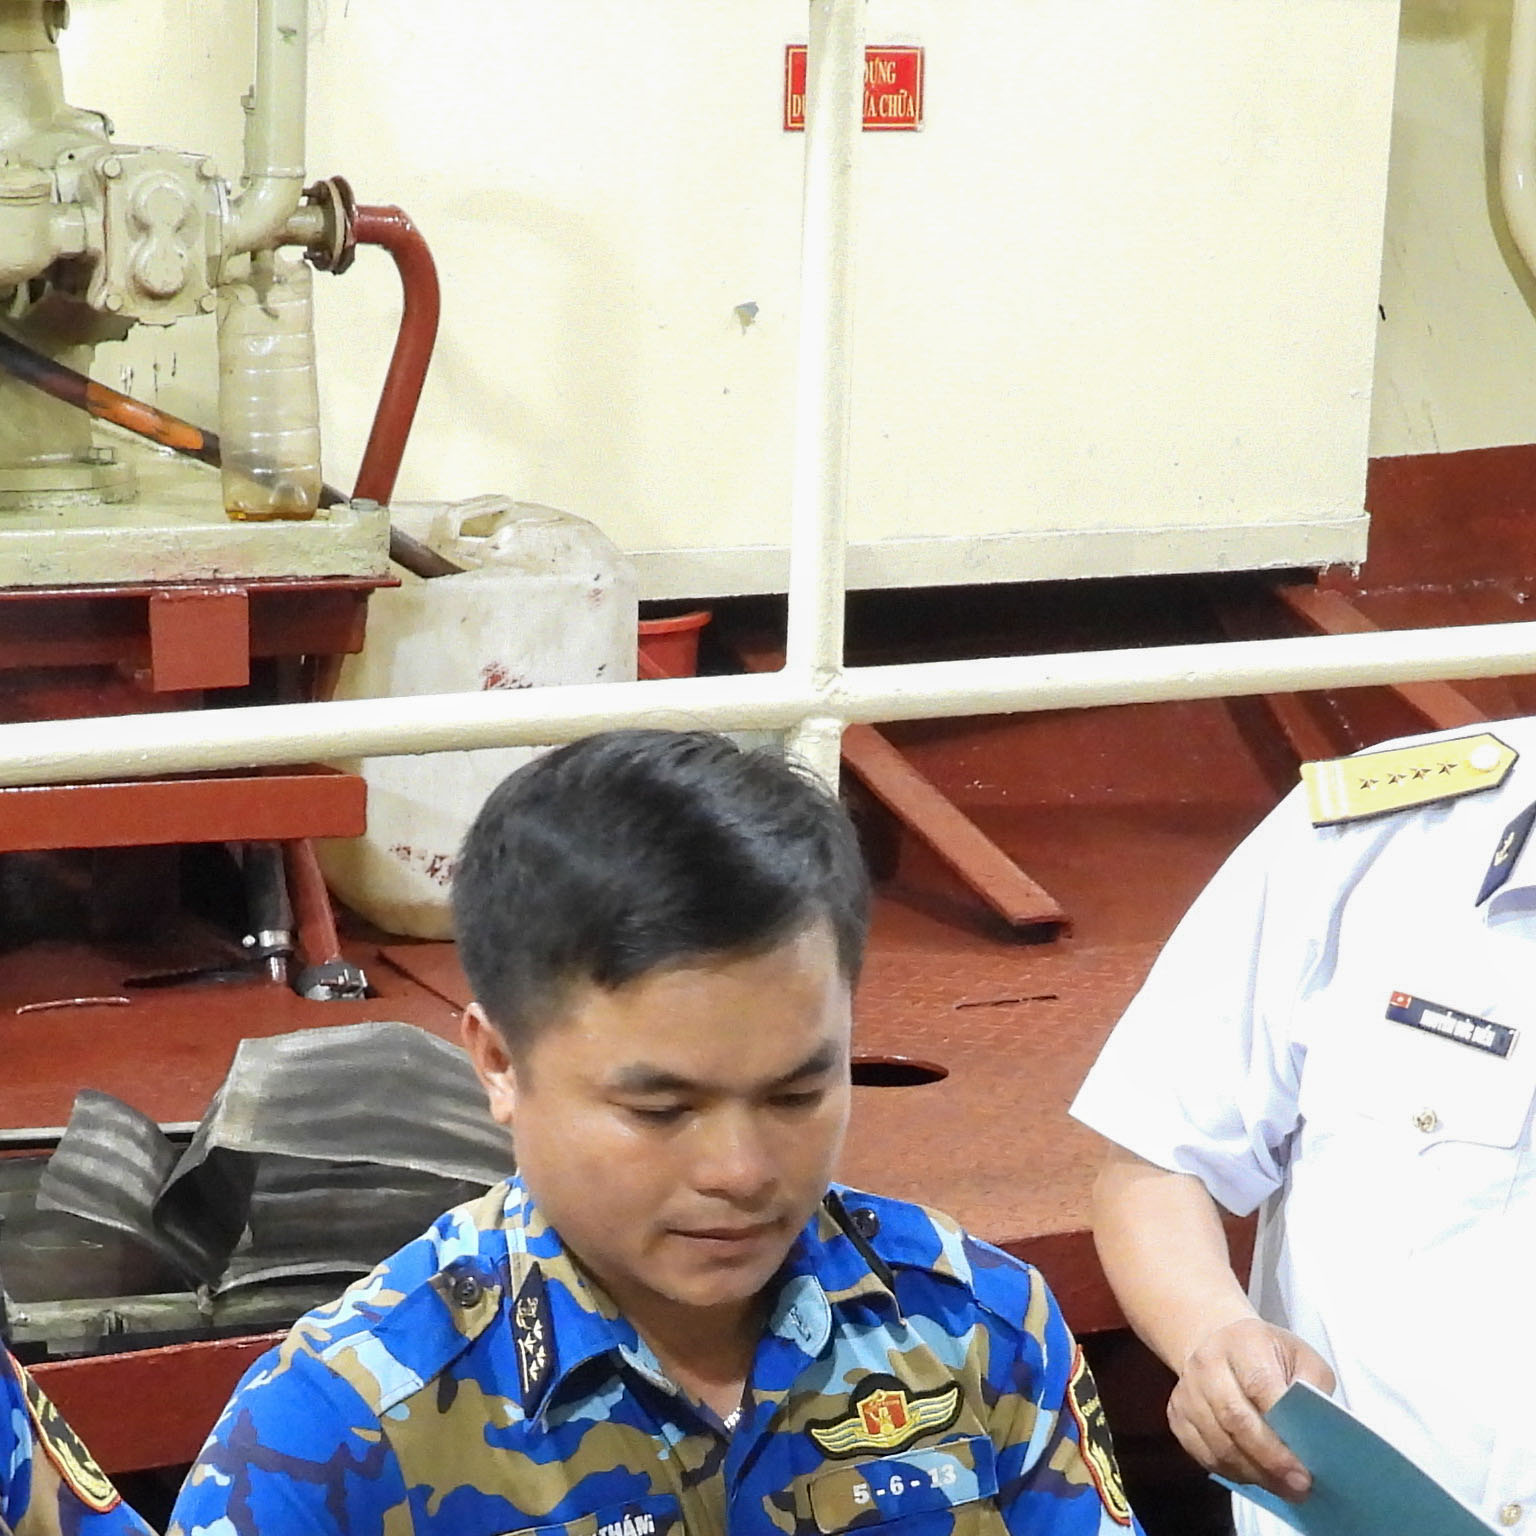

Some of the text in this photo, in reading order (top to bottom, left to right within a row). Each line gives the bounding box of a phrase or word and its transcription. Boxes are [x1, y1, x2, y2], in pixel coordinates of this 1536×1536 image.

[879, 88, 914, 117] CHỮA
[853, 1483, 870, 1504] 5
[889, 1475, 904, 1496] 6
[927, 1463, 957, 1488] 13
